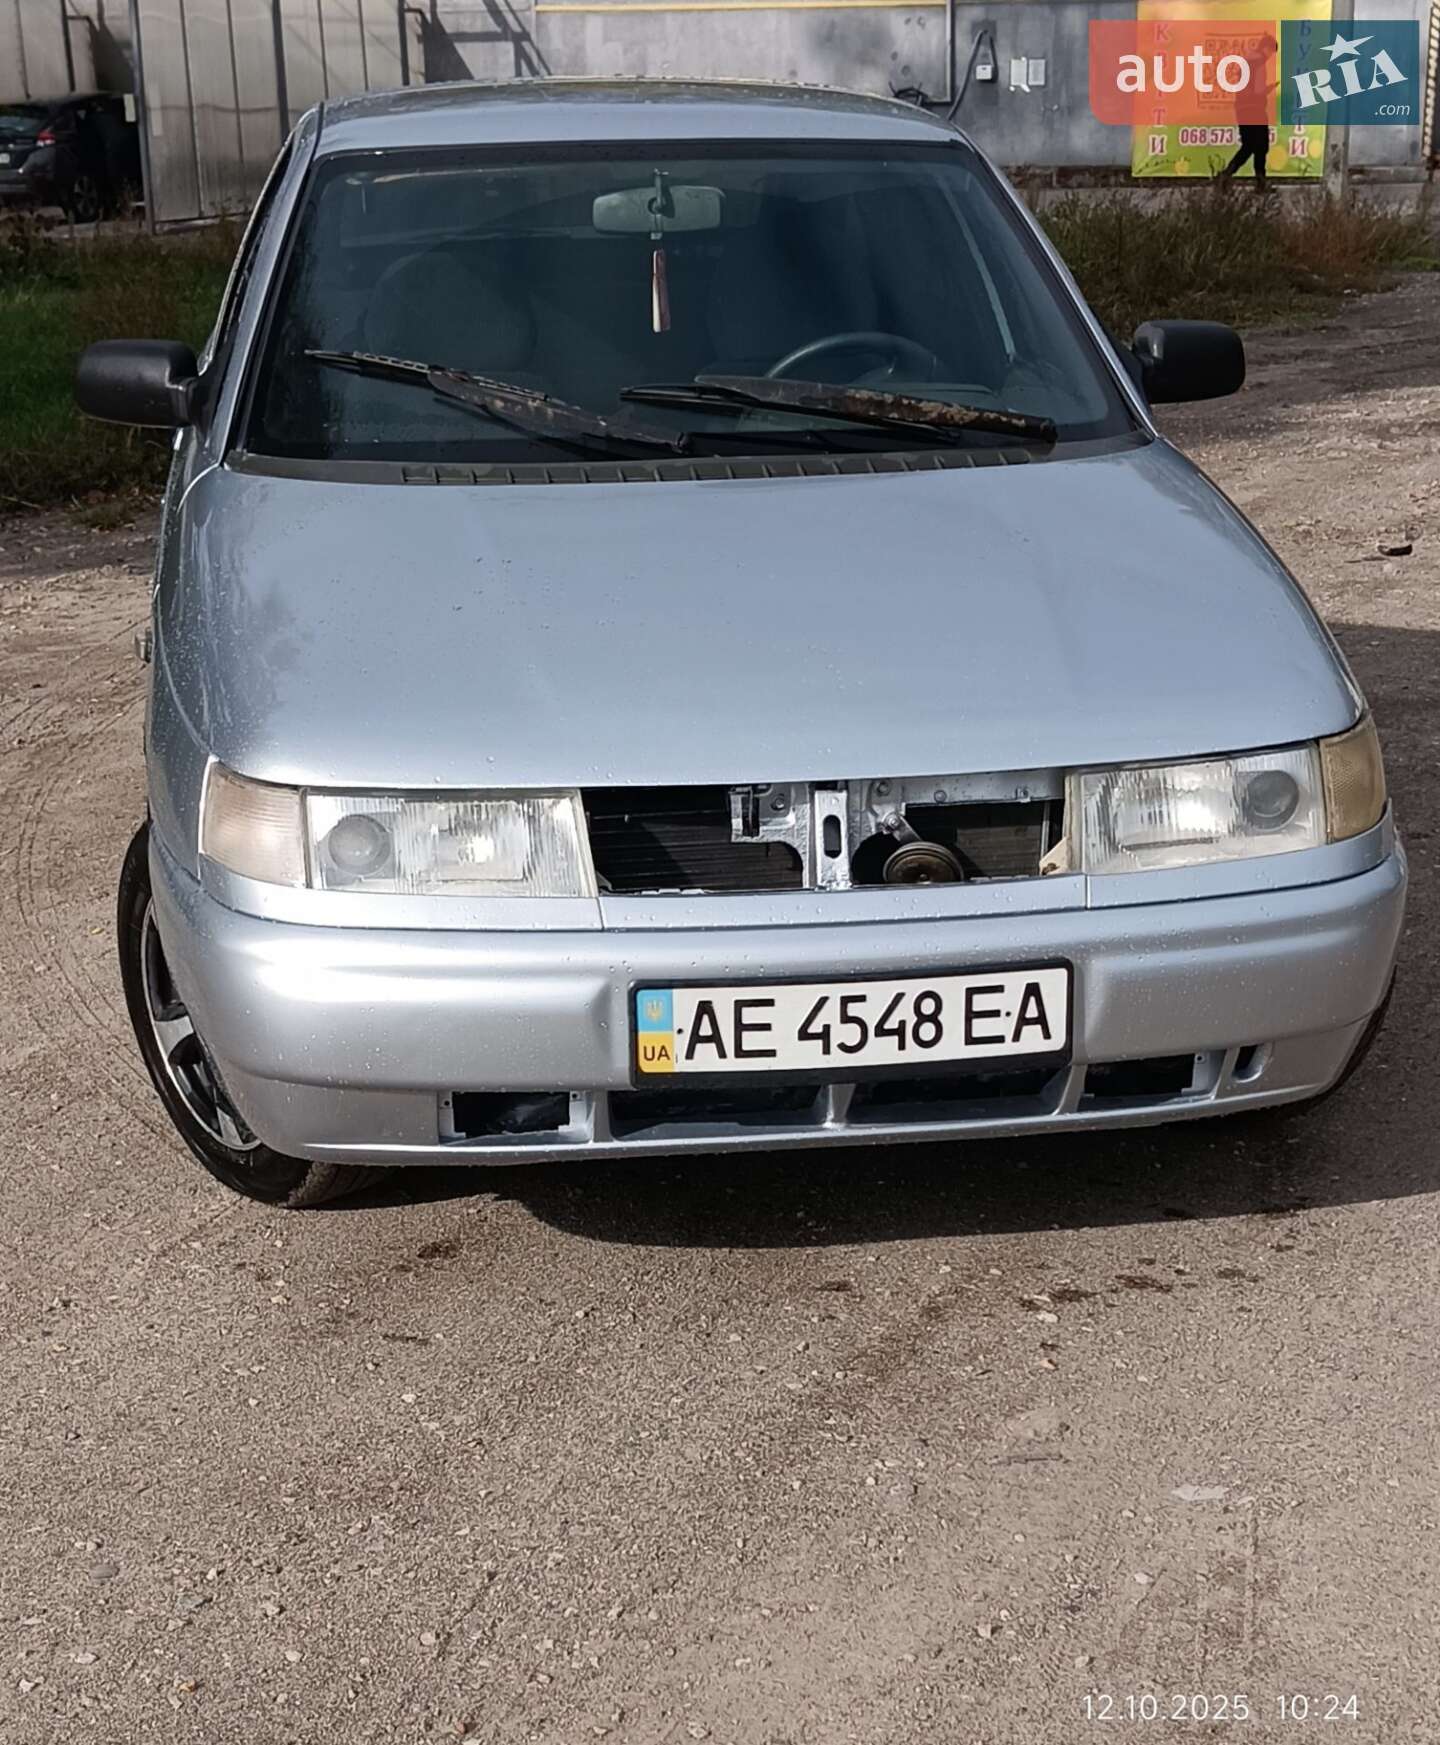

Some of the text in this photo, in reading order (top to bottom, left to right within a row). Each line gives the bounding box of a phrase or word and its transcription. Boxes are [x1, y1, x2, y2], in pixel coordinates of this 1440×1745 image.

[1290, 20, 1312, 156] БУТИ
[1181, 128, 1207, 144] 068
[1210, 128, 1234, 144] 573
[684, 982, 1052, 1061] AE 4548 EA
[643, 1046, 671, 1063] UA
